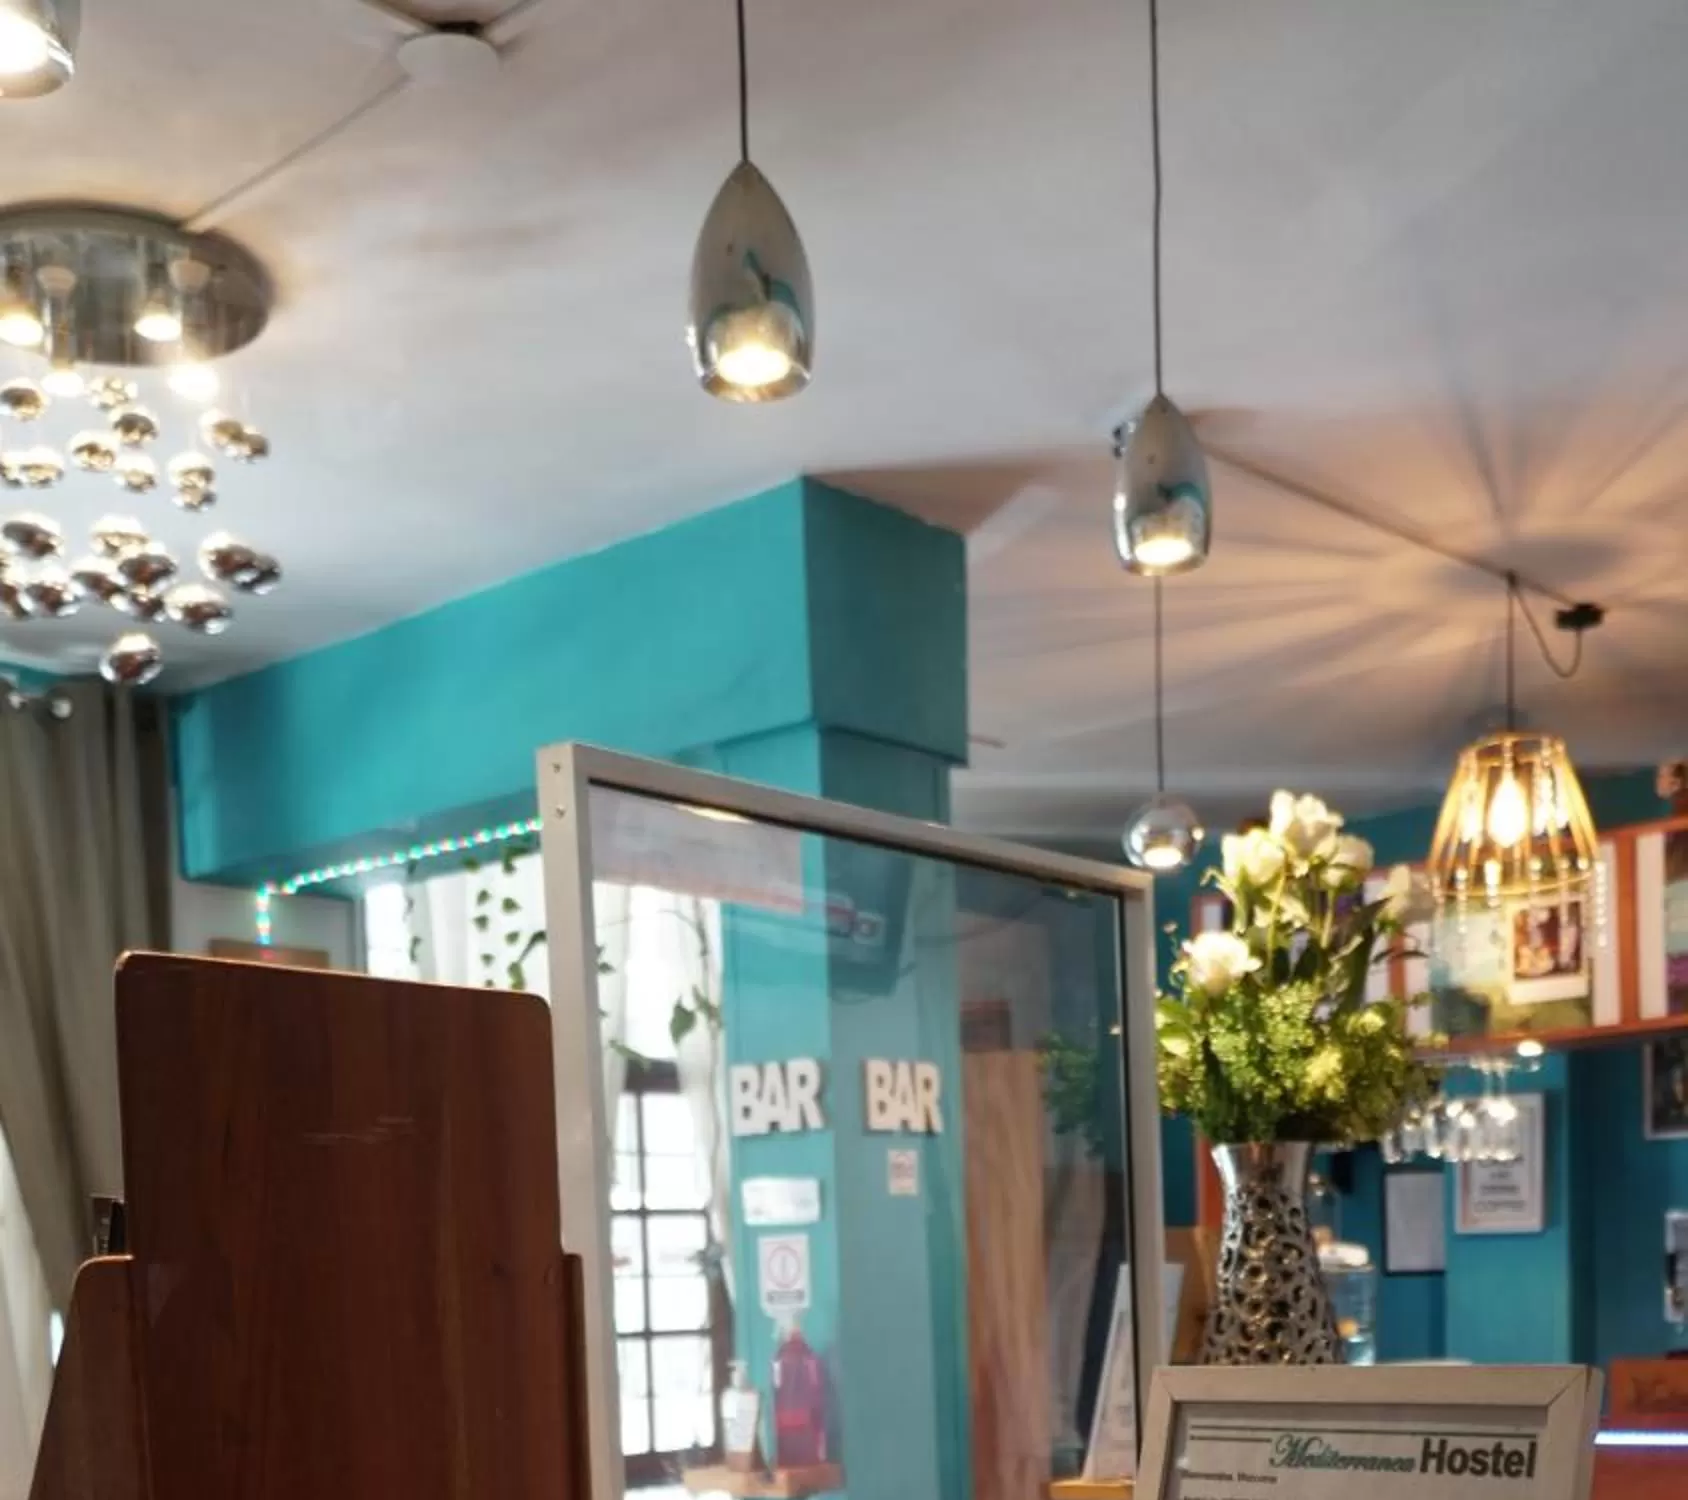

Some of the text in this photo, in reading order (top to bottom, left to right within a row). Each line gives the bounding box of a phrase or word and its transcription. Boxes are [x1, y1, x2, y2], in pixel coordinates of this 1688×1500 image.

[731, 1058, 826, 1137] BAR
[865, 1058, 944, 1134] BAR
[1419, 1437, 1537, 1478] Hostel
